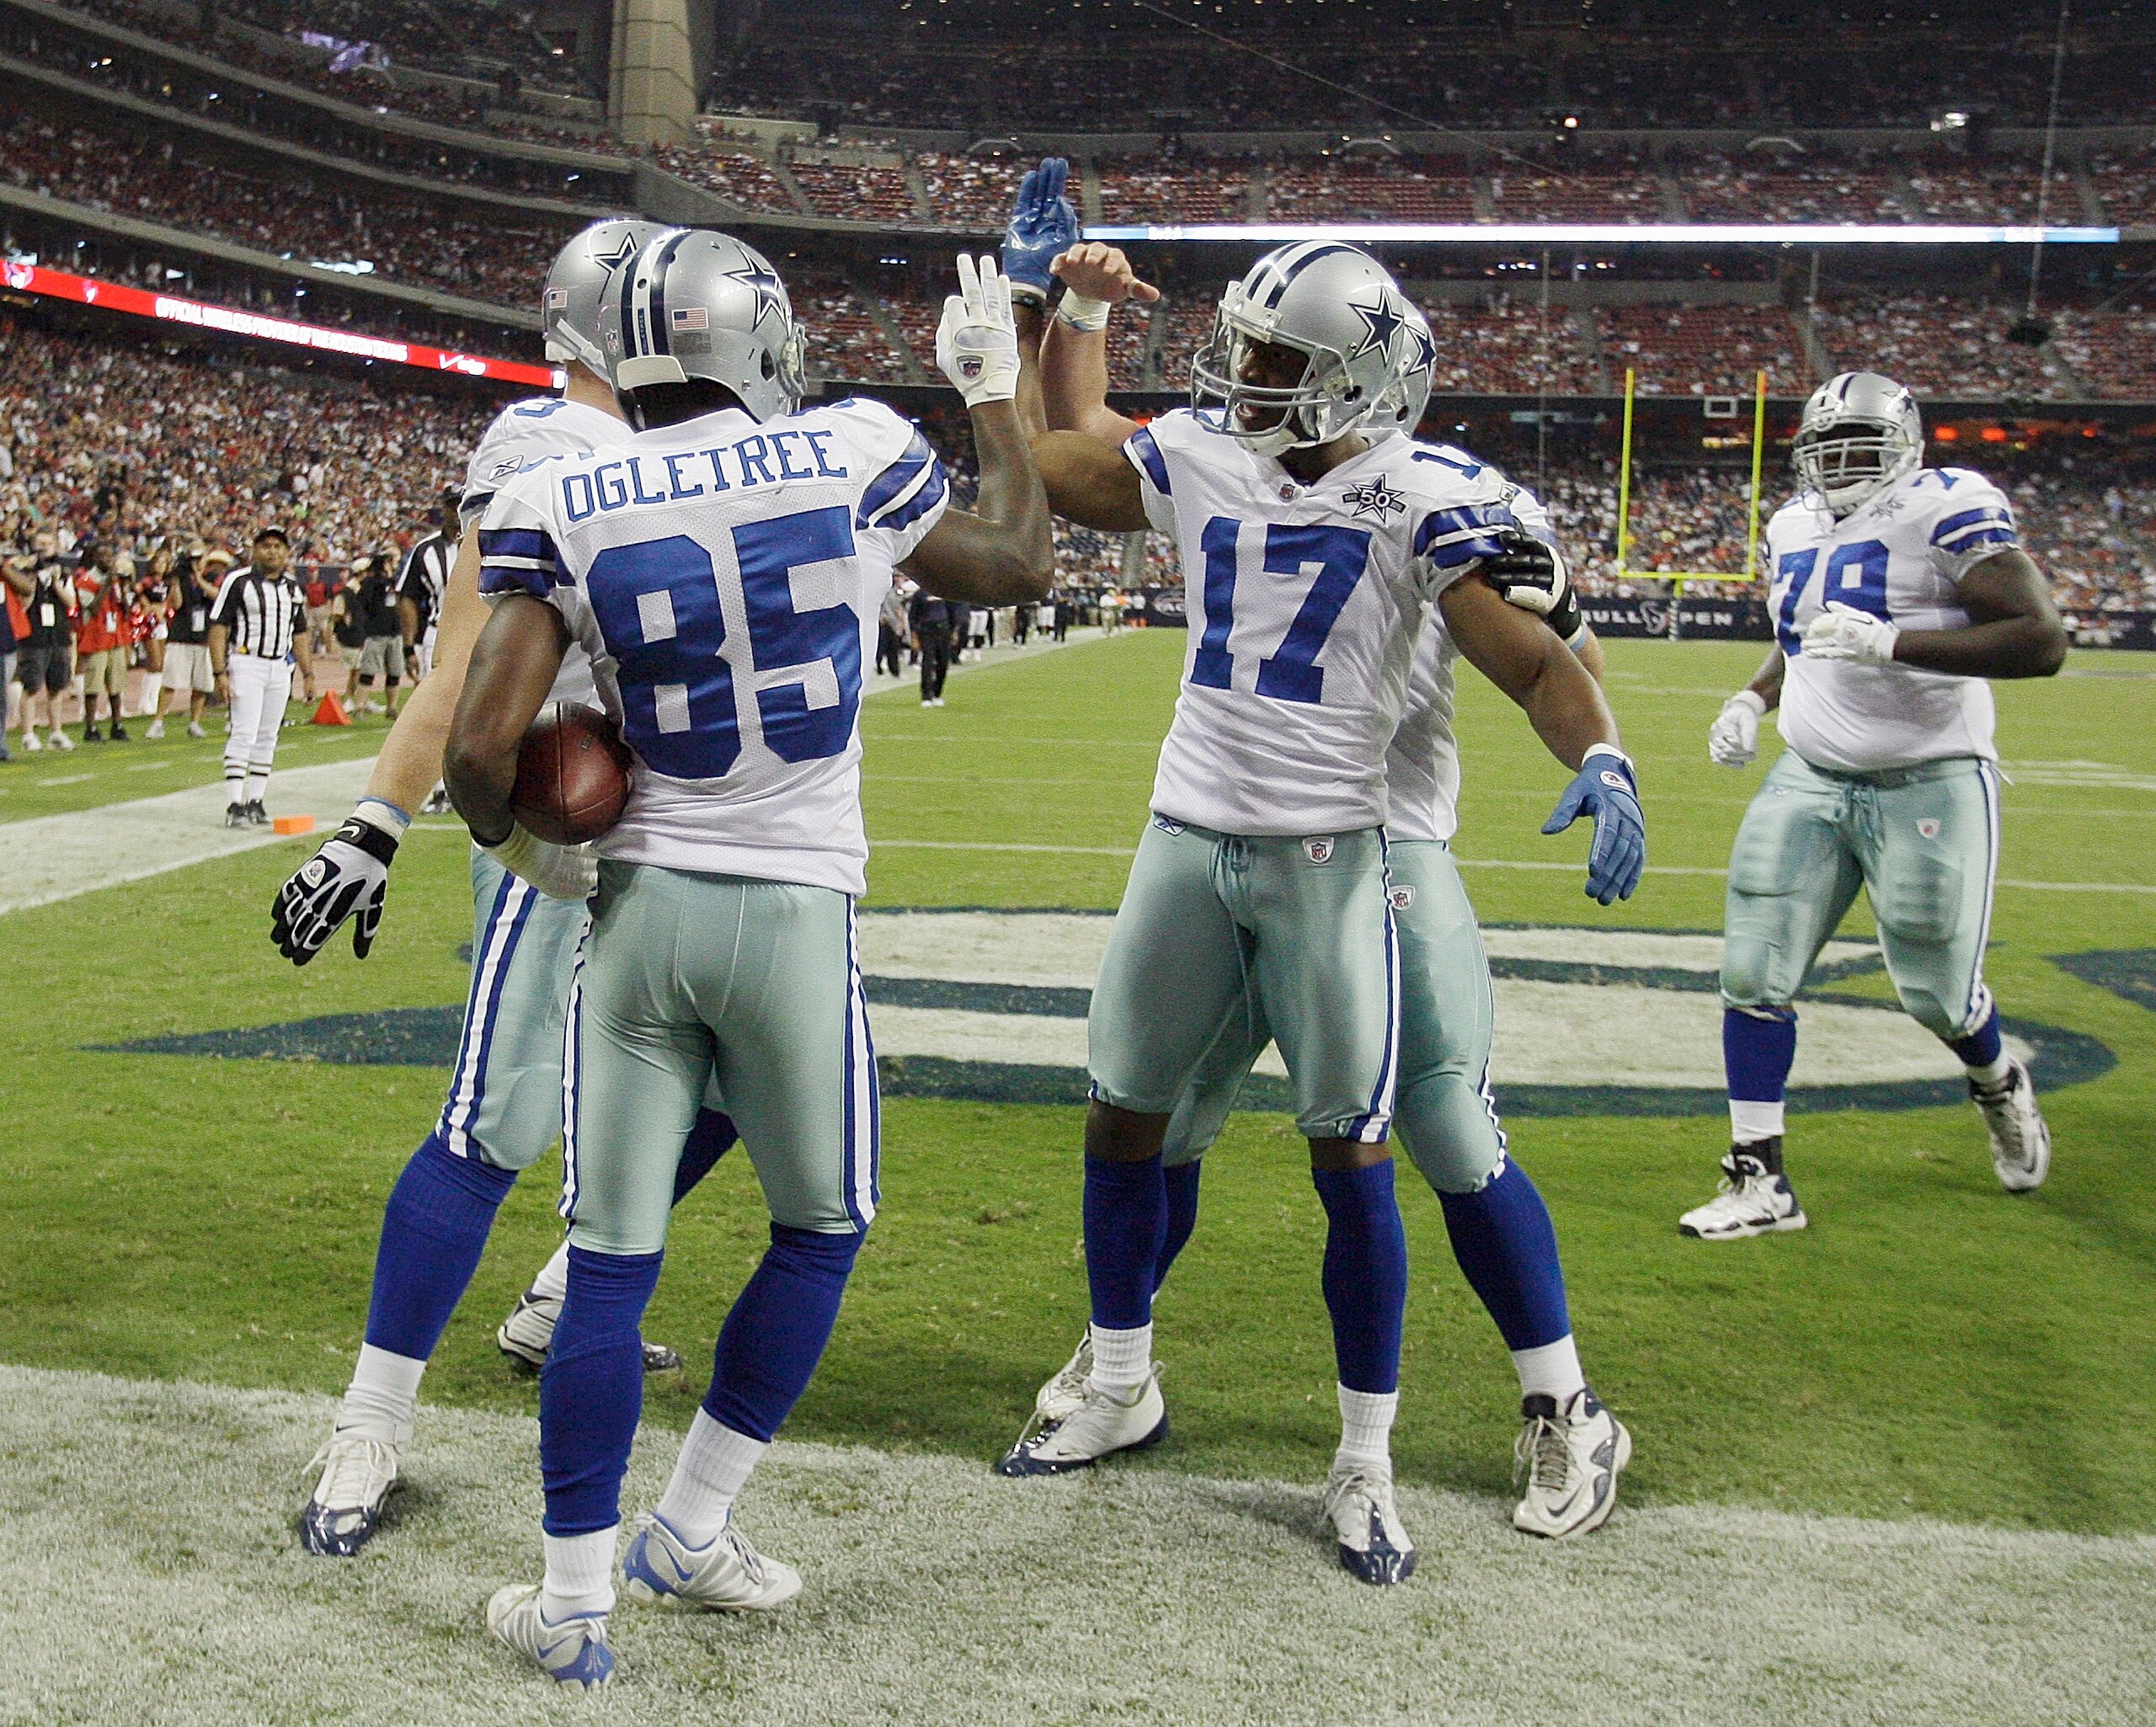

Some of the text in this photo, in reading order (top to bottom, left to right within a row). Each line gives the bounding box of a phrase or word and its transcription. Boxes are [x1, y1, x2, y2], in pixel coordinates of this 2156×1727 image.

[563, 430, 847, 523] OGLETREE
[1359, 488, 1390, 508] 50
[1411, 450, 1481, 480] 1
[585, 504, 862, 780] 85
[1190, 515, 1372, 704] 17
[1678, 611, 1732, 626] PEN
[1774, 539, 1894, 658] 79
